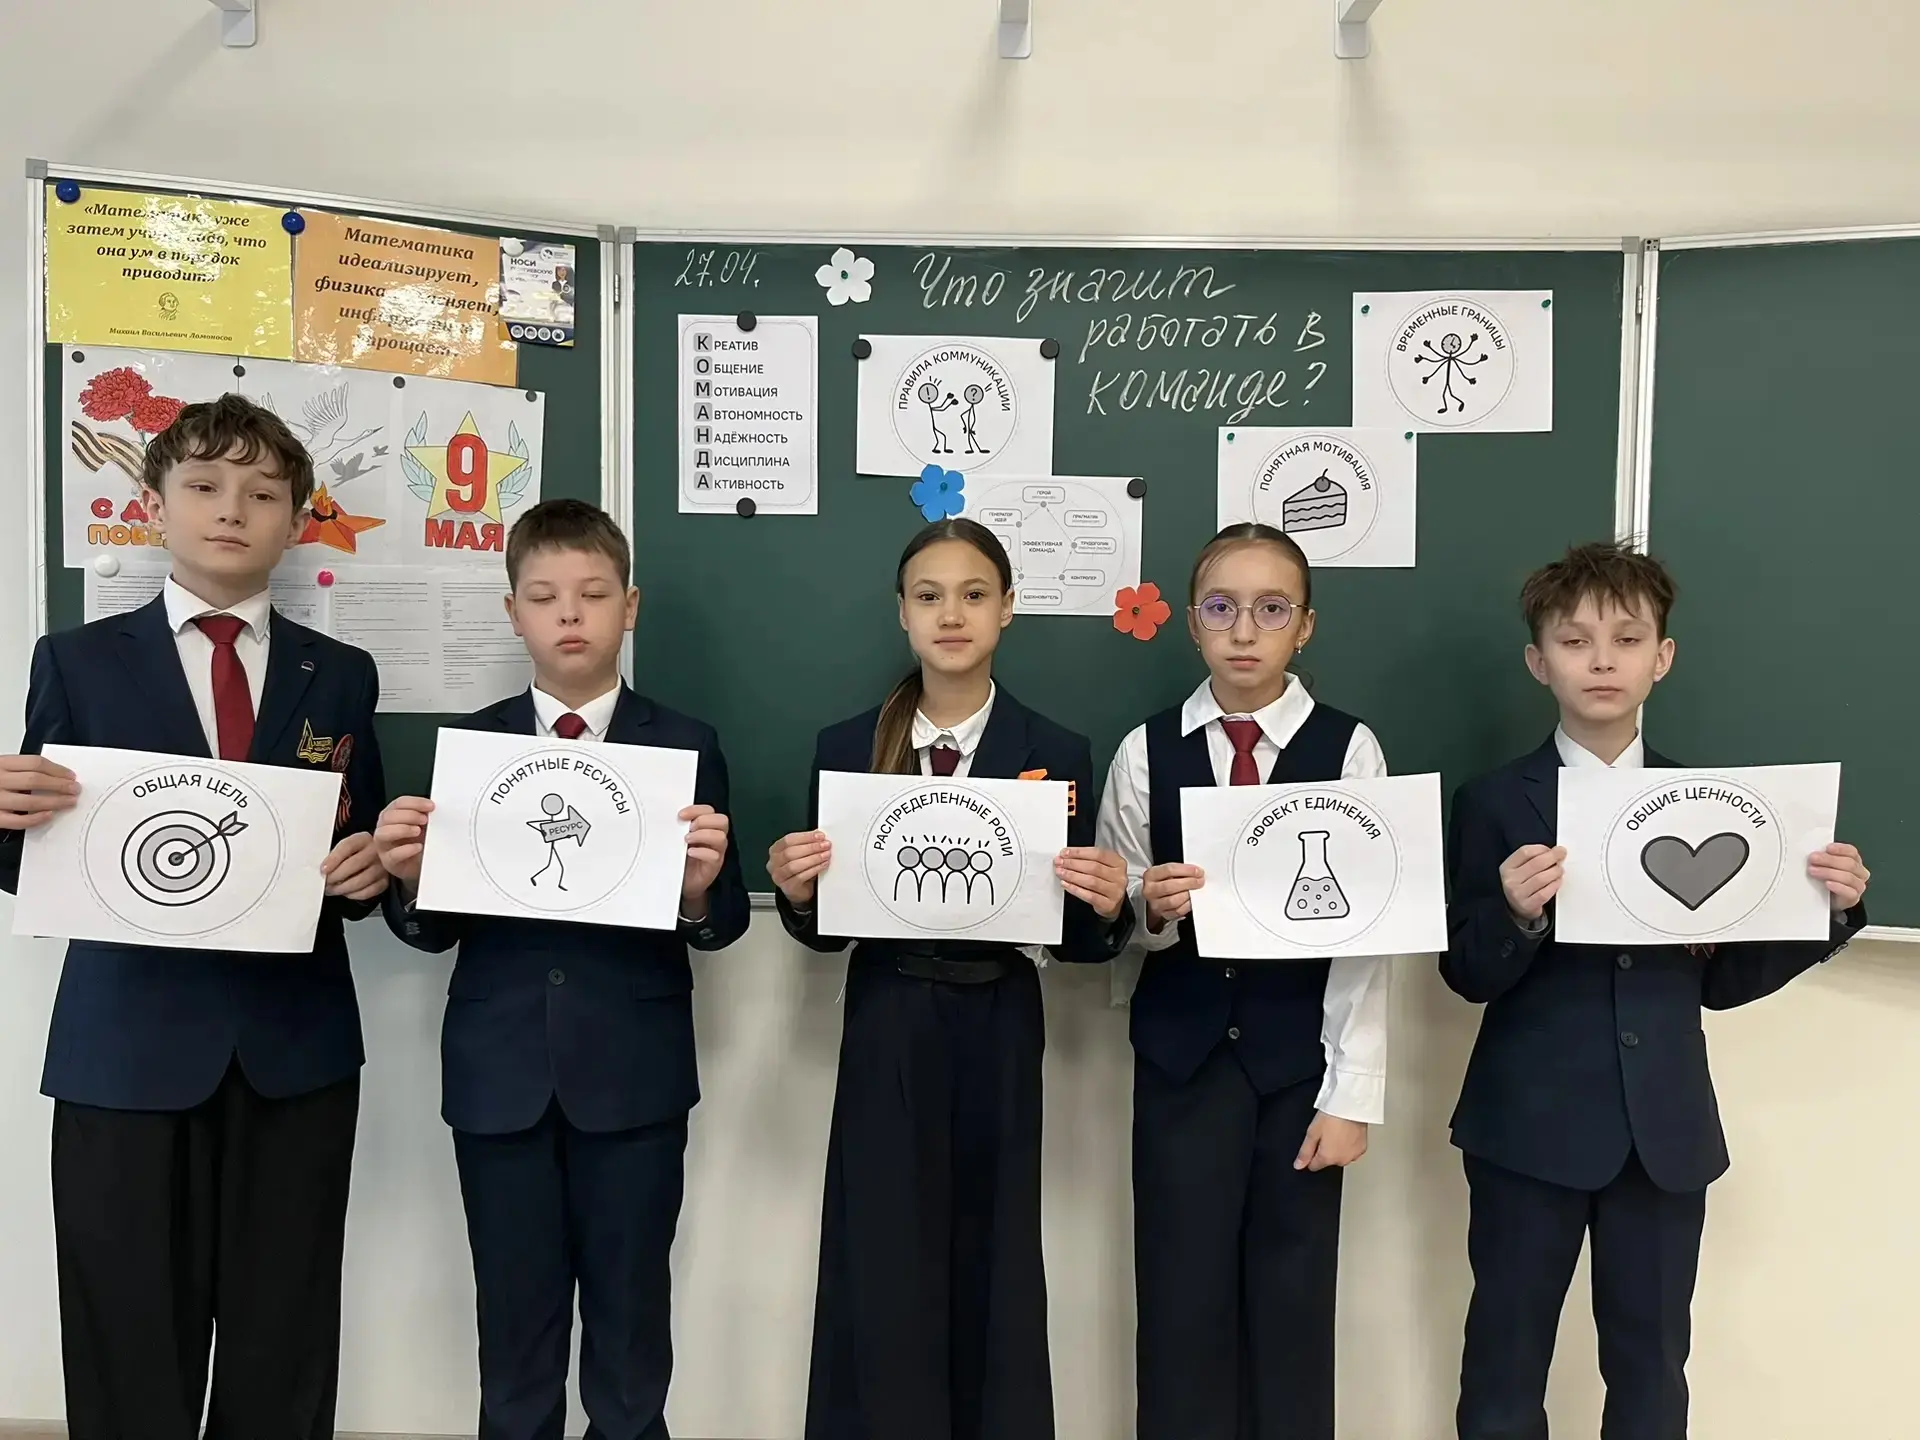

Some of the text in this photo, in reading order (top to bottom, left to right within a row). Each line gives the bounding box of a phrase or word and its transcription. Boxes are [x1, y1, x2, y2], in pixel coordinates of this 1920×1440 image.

[67, 223, 124, 237] затем
[233, 237, 267, 249] что
[96, 246, 126, 257] она
[129, 248, 153, 260] ум
[157, 250, 167, 260] в
[344, 227, 475, 260] Математика
[338, 253, 480, 288] идеализирует,
[510, 258, 536, 267] НОСИ
[314, 275, 386, 298] физика
[913, 252, 1236, 323] Что значит
[109, 328, 233, 341] Михаил Васильевич Ломоносов
[1078, 313, 1278, 364] работать
[1397, 305, 1506, 352] ВРЕМЕННЫЕ ГРАНИЦЫ
[899, 351, 1011, 412] ПРАВИЛА КОММУНИКАЦИИ
[446, 433, 488, 514] 9
[1260, 441, 1371, 491] ПОНЯТНАЯ МОТИВАЦИЯ
[91, 498, 113, 518] С
[425, 518, 504, 552] МАЯ
[132, 773, 249, 809] ОБЩАЯ ЦЕЛЬ
[490, 757, 630, 815] ПОНЯТНЫЕ РЕСУРСЫ
[874, 792, 1014, 857] РАСПРЕДЕЛЕННЫЕ РОЛИ
[1246, 797, 1381, 847] ЭФФЕКТ ЕДИНЕНИЯ
[1626, 787, 1767, 831] ОБЩИЕ ЦЕННОСТИ
[549, 821, 583, 836] РЕСУРС
